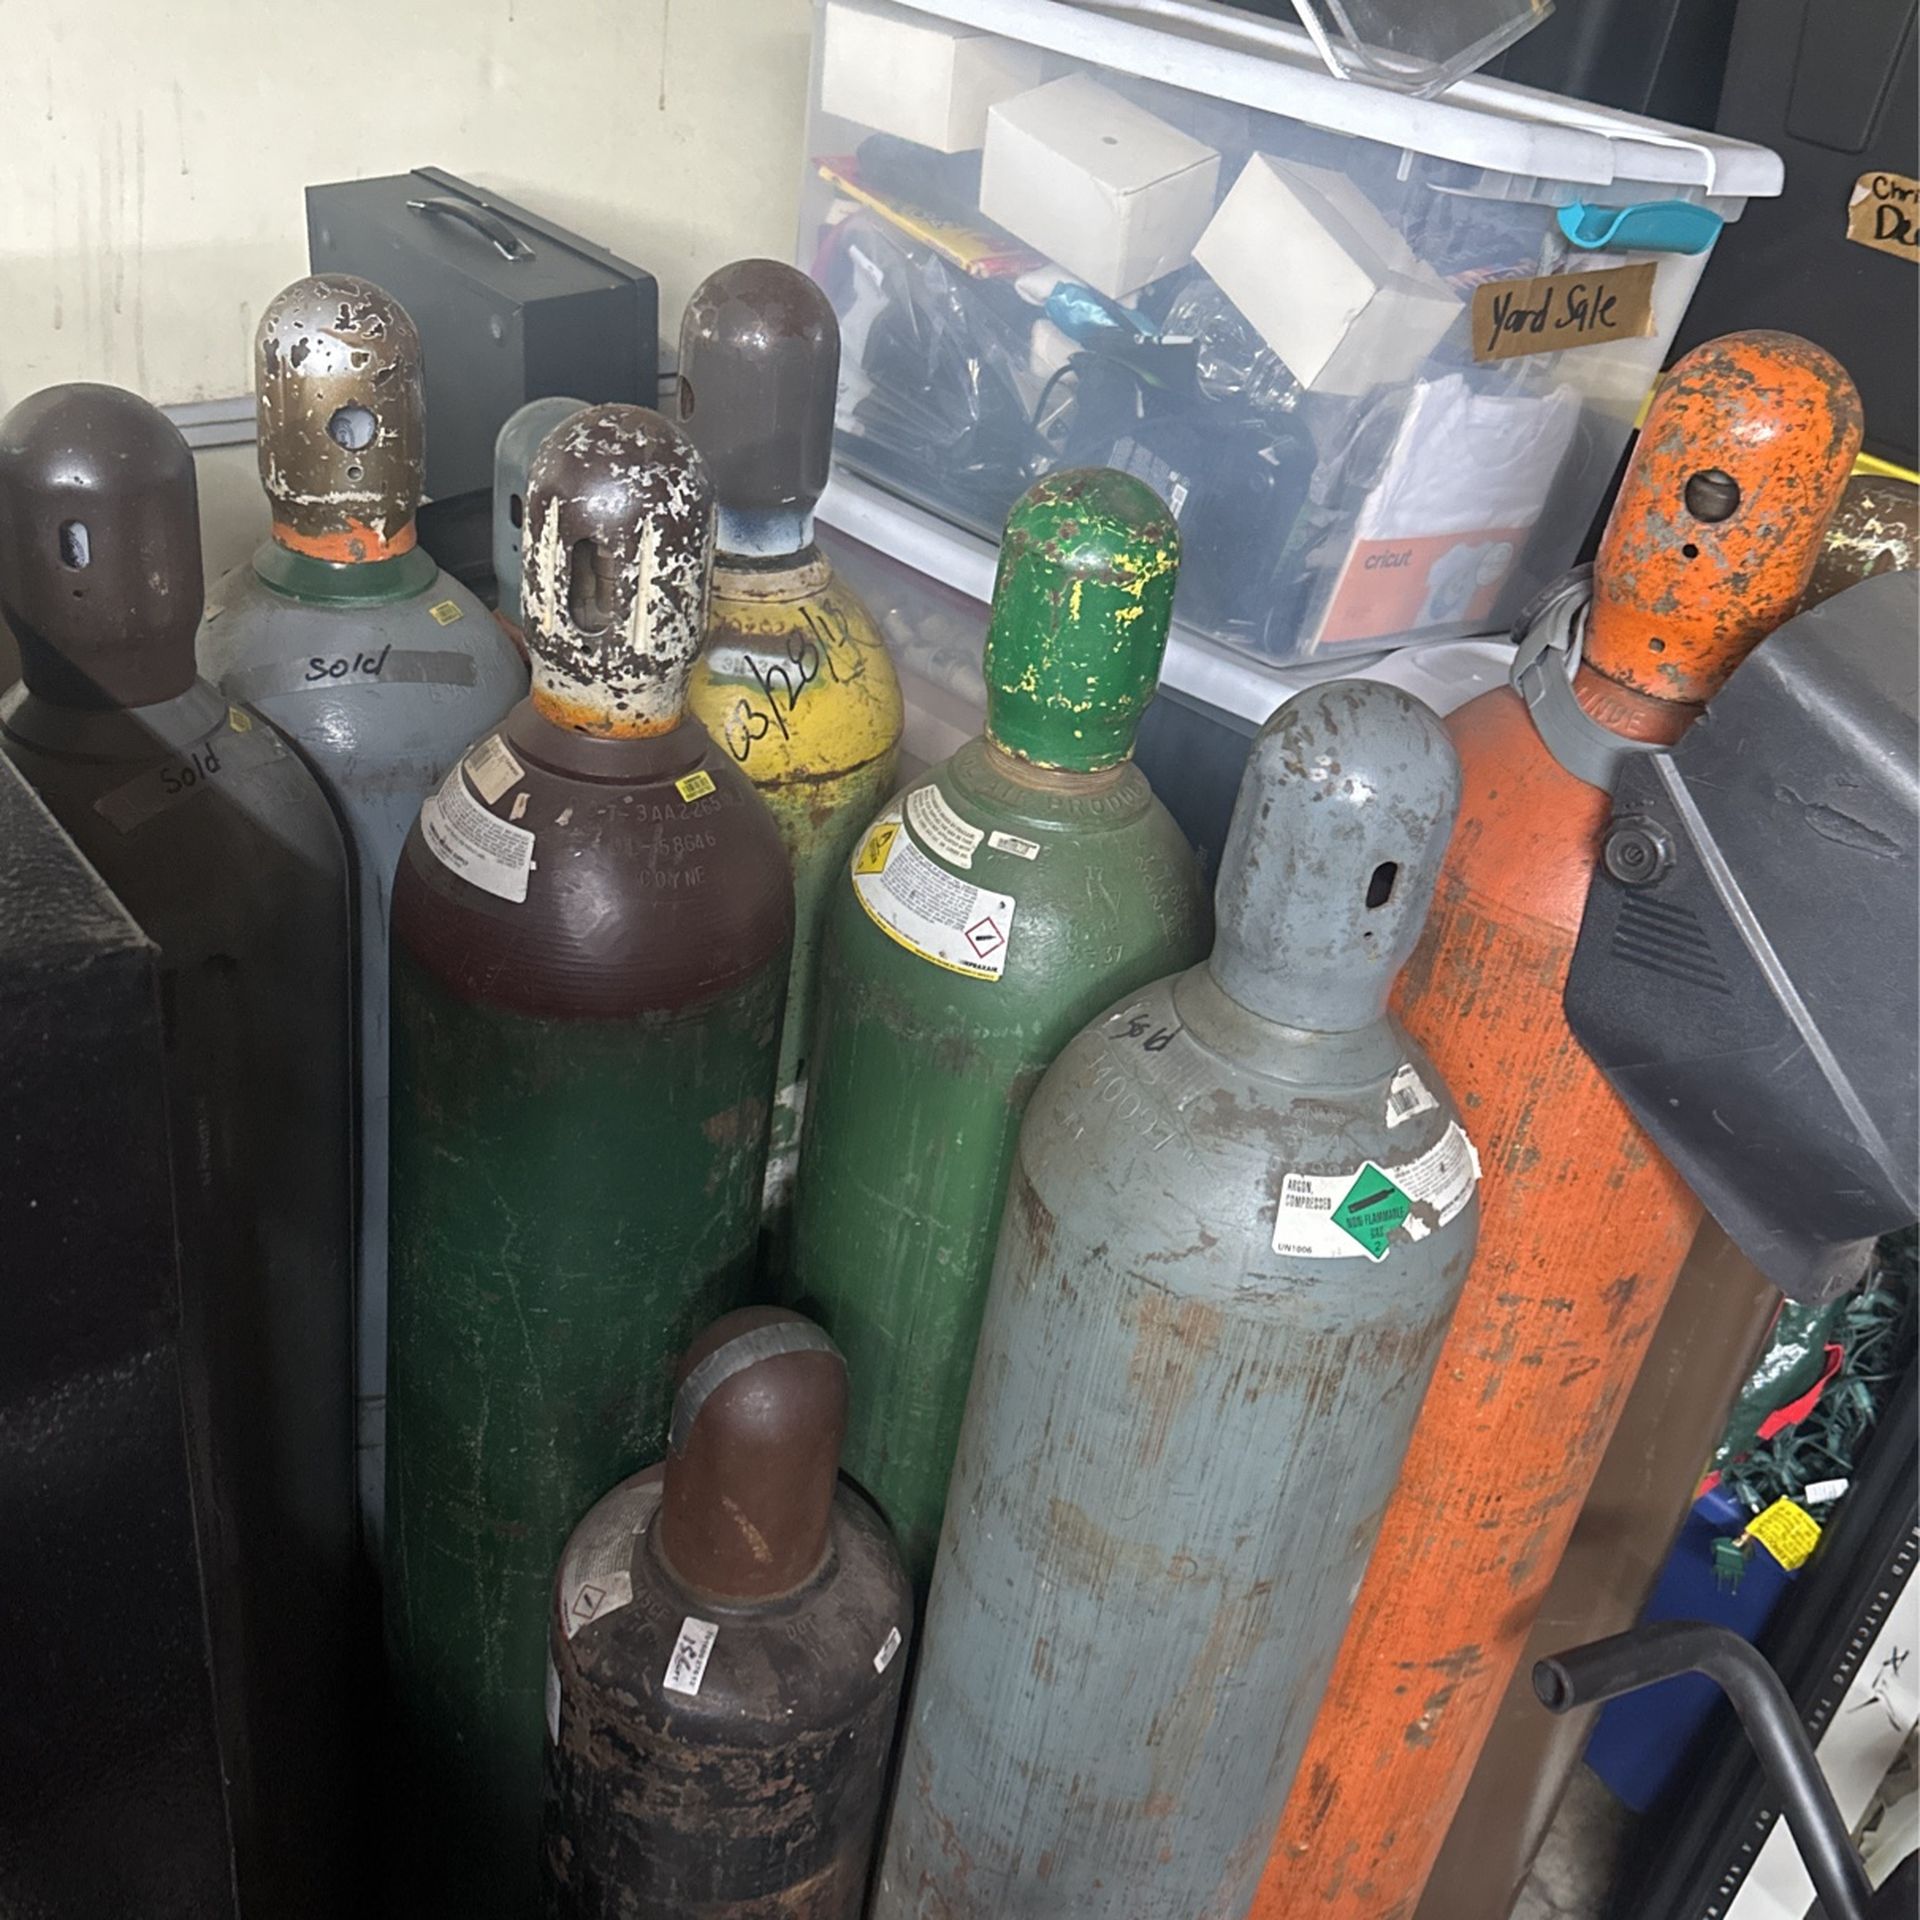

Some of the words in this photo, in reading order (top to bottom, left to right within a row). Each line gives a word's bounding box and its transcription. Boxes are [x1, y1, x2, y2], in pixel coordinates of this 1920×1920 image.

[1487, 286, 1553, 351] Yard
[1556, 284, 1617, 331] Sale
[1364, 549, 1412, 570] cricut
[161, 741, 222, 794] Sold
[1277, 1243, 1313, 1254] UN1006
[1374, 1240, 1382, 1252] 2
